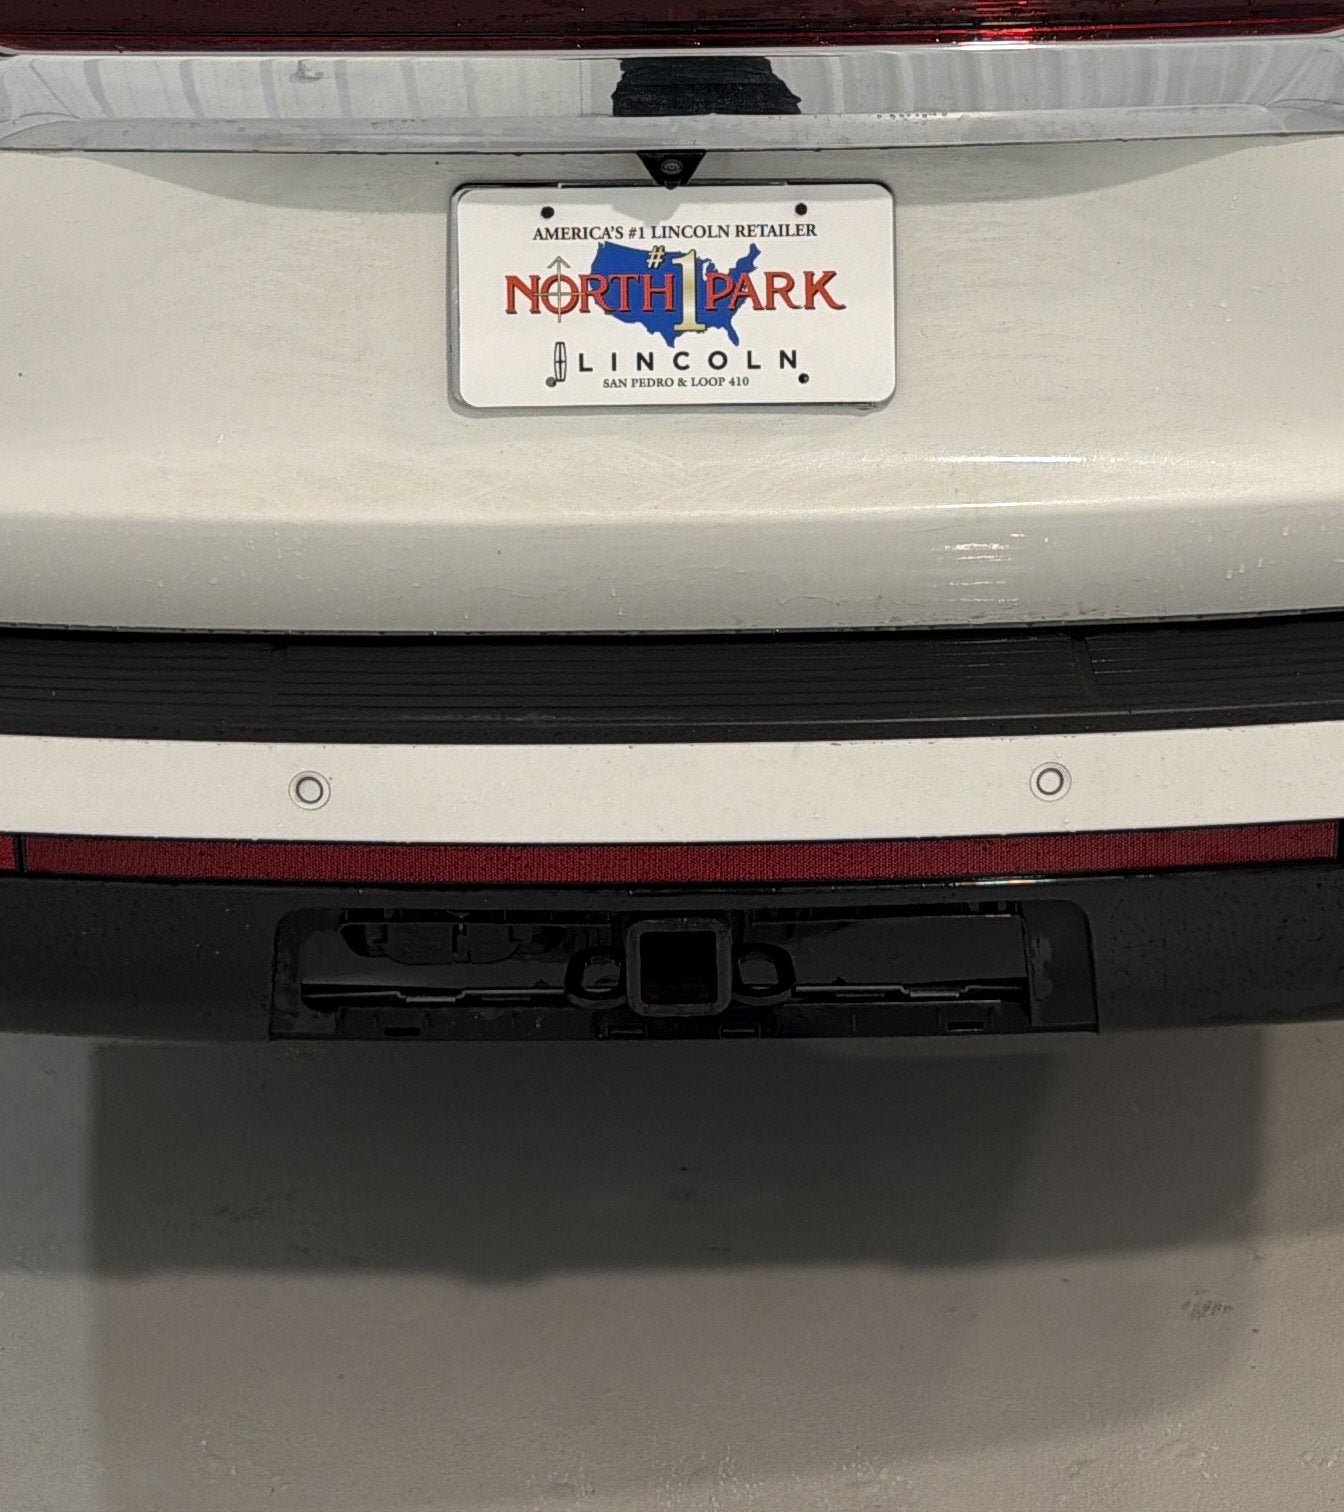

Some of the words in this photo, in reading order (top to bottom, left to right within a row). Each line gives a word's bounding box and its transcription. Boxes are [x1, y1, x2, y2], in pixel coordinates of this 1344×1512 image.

[532, 226, 624, 240] AMERICA'S
[628, 226, 646, 239] #1
[651, 225, 730, 239] LINCOLN
[734, 223, 818, 238] RETAILER
[504, 273, 676, 315] NORTH
[705, 271, 847, 311] PARK
[579, 349, 798, 372] LINCOLN
[602, 378, 628, 388] SAN
[631, 377, 675, 388] PEDRO
[678, 377, 688, 387] &
[691, 376, 725, 387] LOOP
[728, 376, 750, 387] 410
